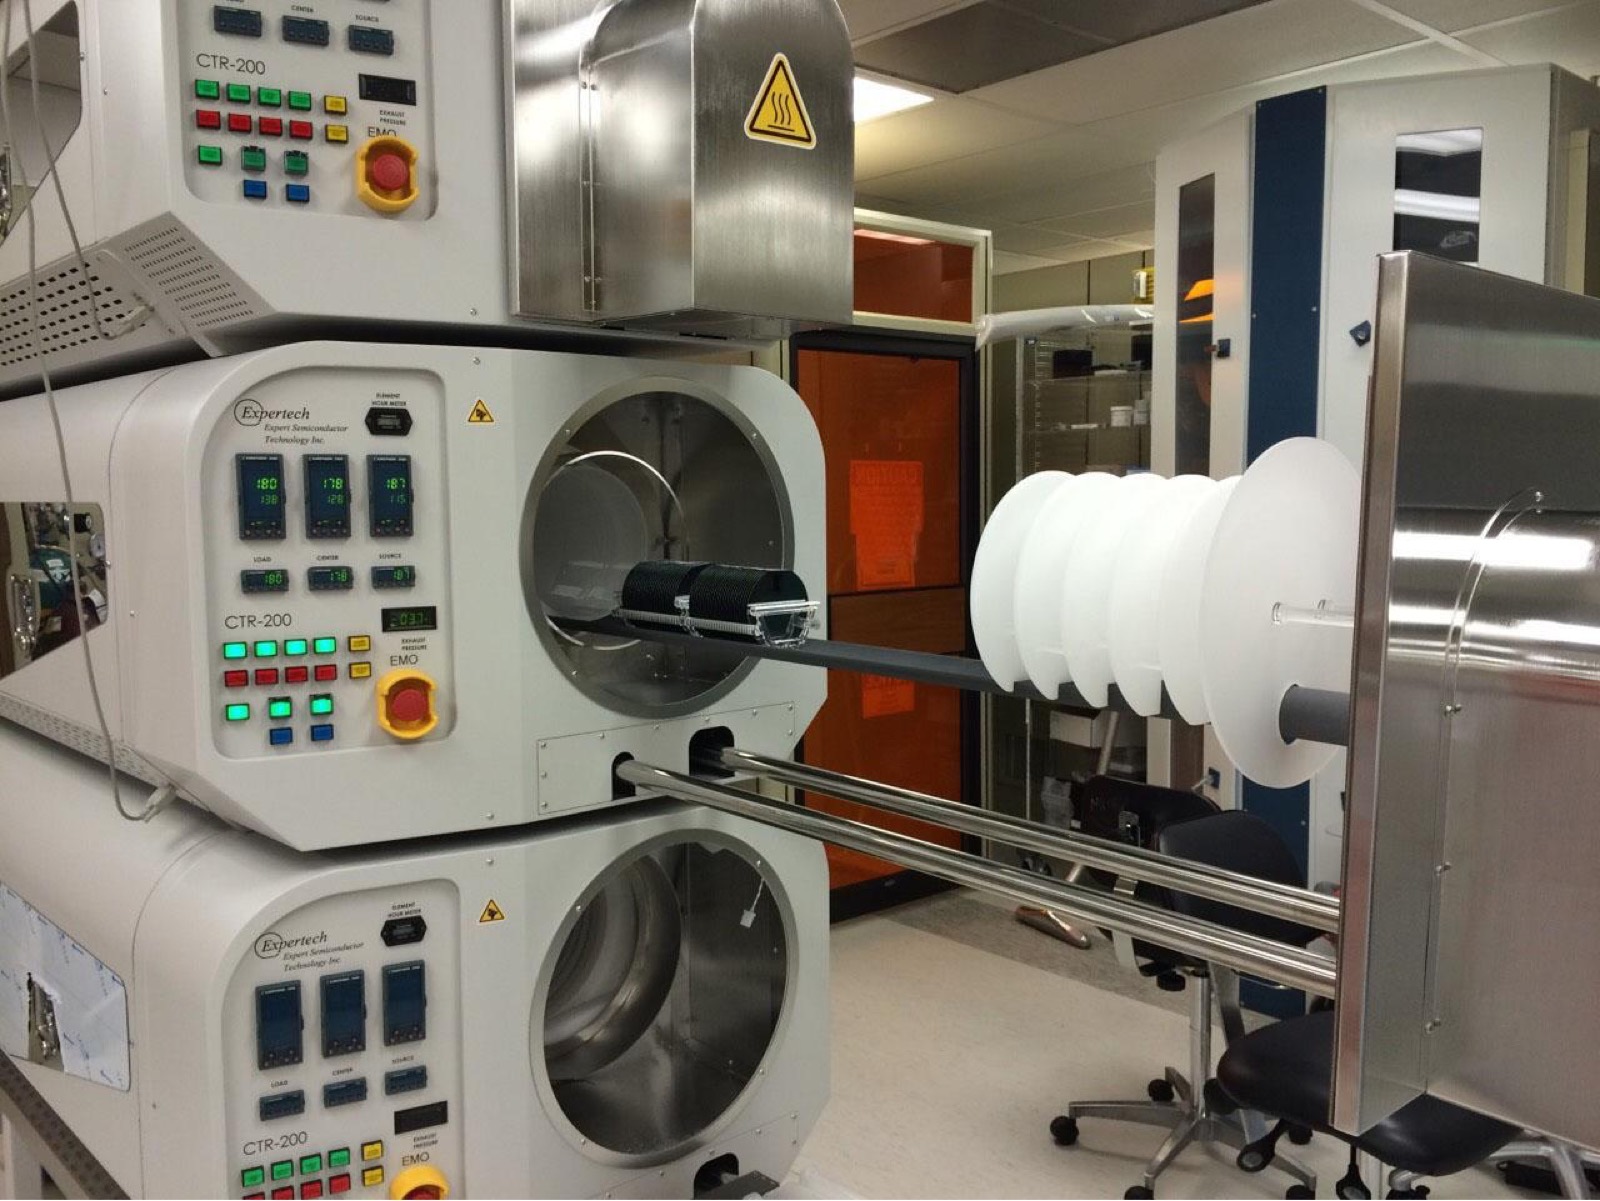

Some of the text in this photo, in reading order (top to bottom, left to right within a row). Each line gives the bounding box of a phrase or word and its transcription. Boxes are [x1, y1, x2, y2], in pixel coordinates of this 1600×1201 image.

[196, 53, 266, 75] CTR-200
[368, 126, 397, 137] EMO
[239, 405, 310, 422] Expertech
[264, 423, 349, 433] Expert Semiconductor
[265, 435, 310, 446] Technology
[256, 477, 277, 490] 180
[323, 477, 343, 490] 178
[386, 477, 406, 490] 187
[224, 613, 292, 629] CTR-200
[390, 654, 418, 666] EMO
[260, 931, 328, 954] Expertech
[284, 942, 365, 962] Expert Semiconductor
[284, 960, 326, 972] Technology
[243, 1131, 308, 1156] CTR-200
[402, 1151, 430, 1166] EMO
